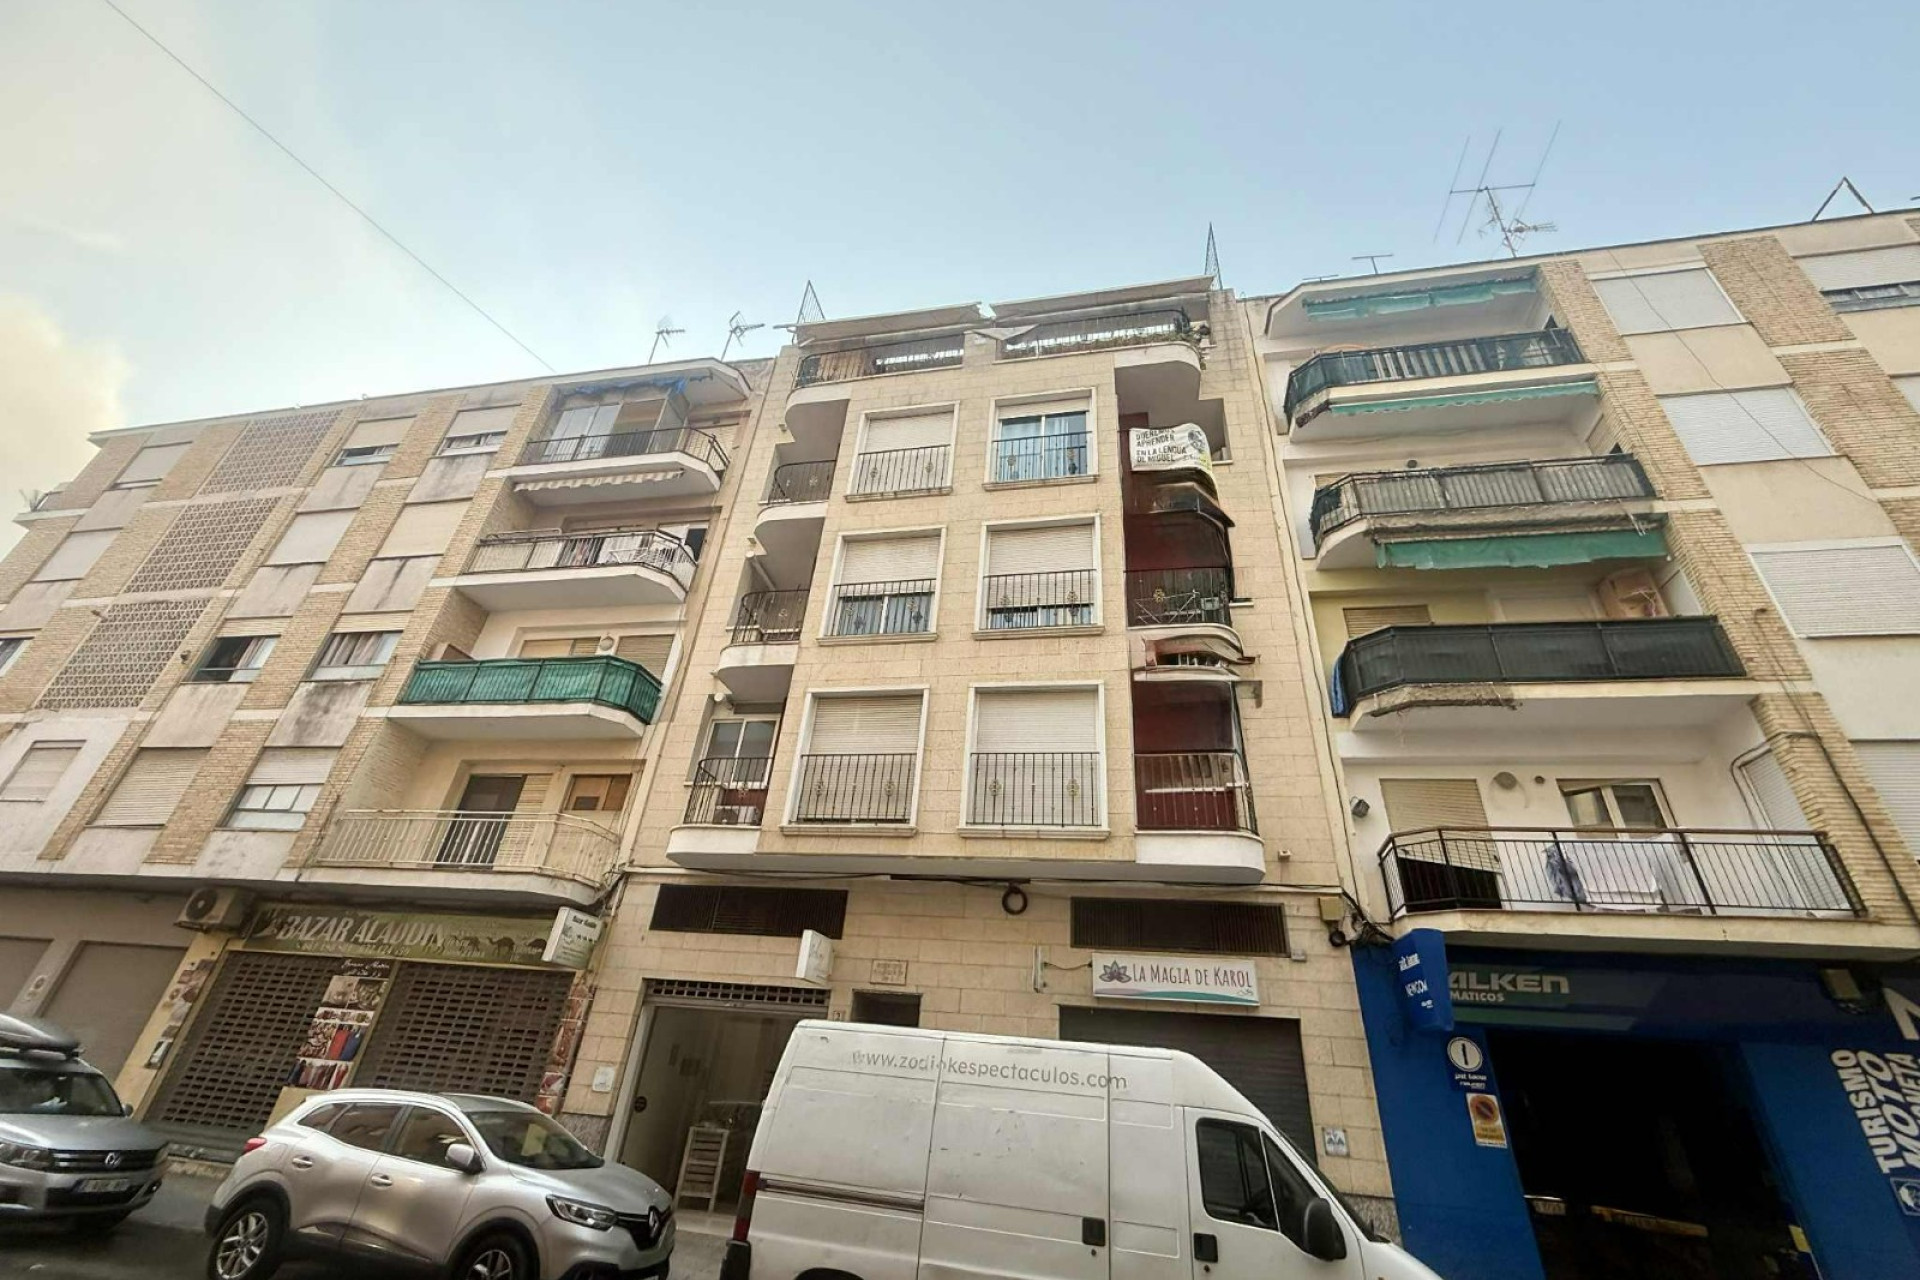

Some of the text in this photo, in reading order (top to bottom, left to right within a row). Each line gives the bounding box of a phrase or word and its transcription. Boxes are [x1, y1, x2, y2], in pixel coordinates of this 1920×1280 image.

[277, 915, 350, 942] BAZAR
[1133, 963, 1252, 989] LA MAGIA DE KAROL
[1448, 971, 1570, 994] ALKEN
[1450, 990, 1505, 1003] MATICOS
[1831, 1050, 1906, 1174] TURISMO
